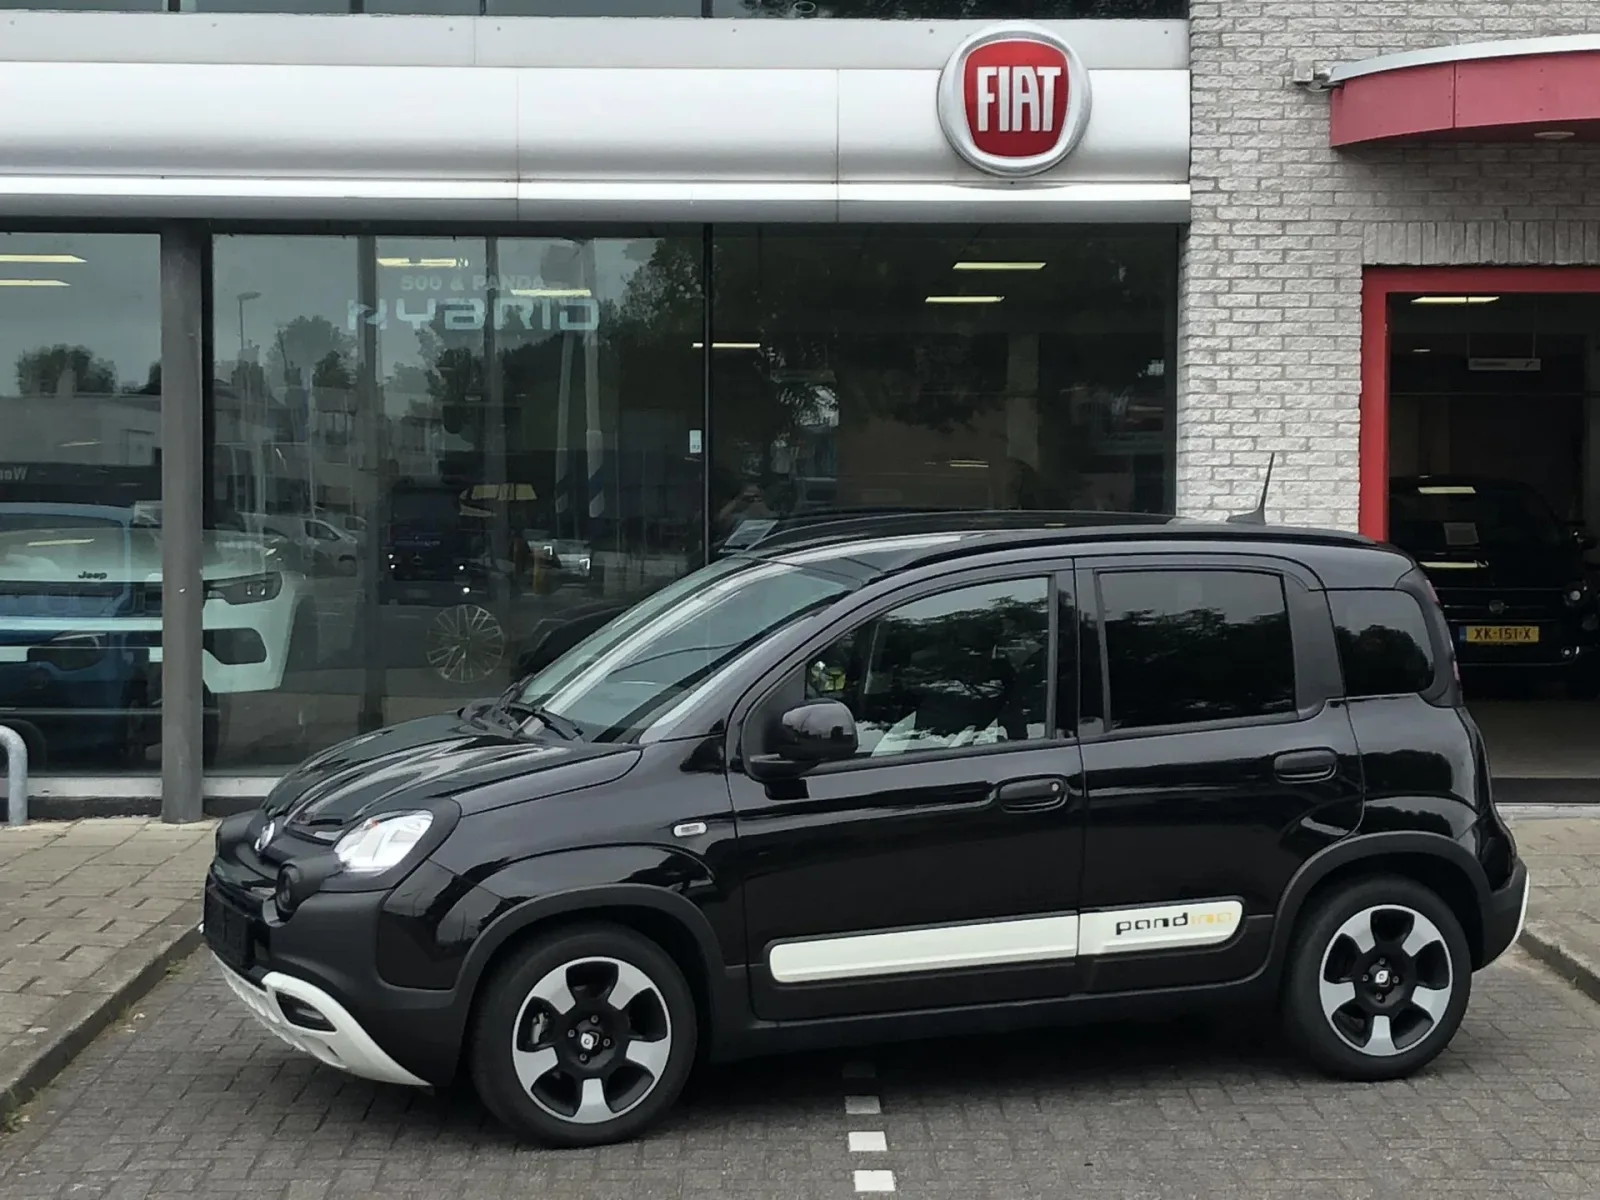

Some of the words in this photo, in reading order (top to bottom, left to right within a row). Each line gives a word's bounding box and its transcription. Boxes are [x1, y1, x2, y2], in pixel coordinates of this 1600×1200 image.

[977, 66, 1062, 132] FIAT
[400, 275, 442, 290] 500
[450, 276, 465, 290] &
[472, 275, 546, 290] PANDA
[347, 297, 600, 330] HYBRID
[78, 571, 107, 580] Jeep
[1474, 627, 1532, 640] XK-151-X
[1115, 912, 1233, 936] pandina
